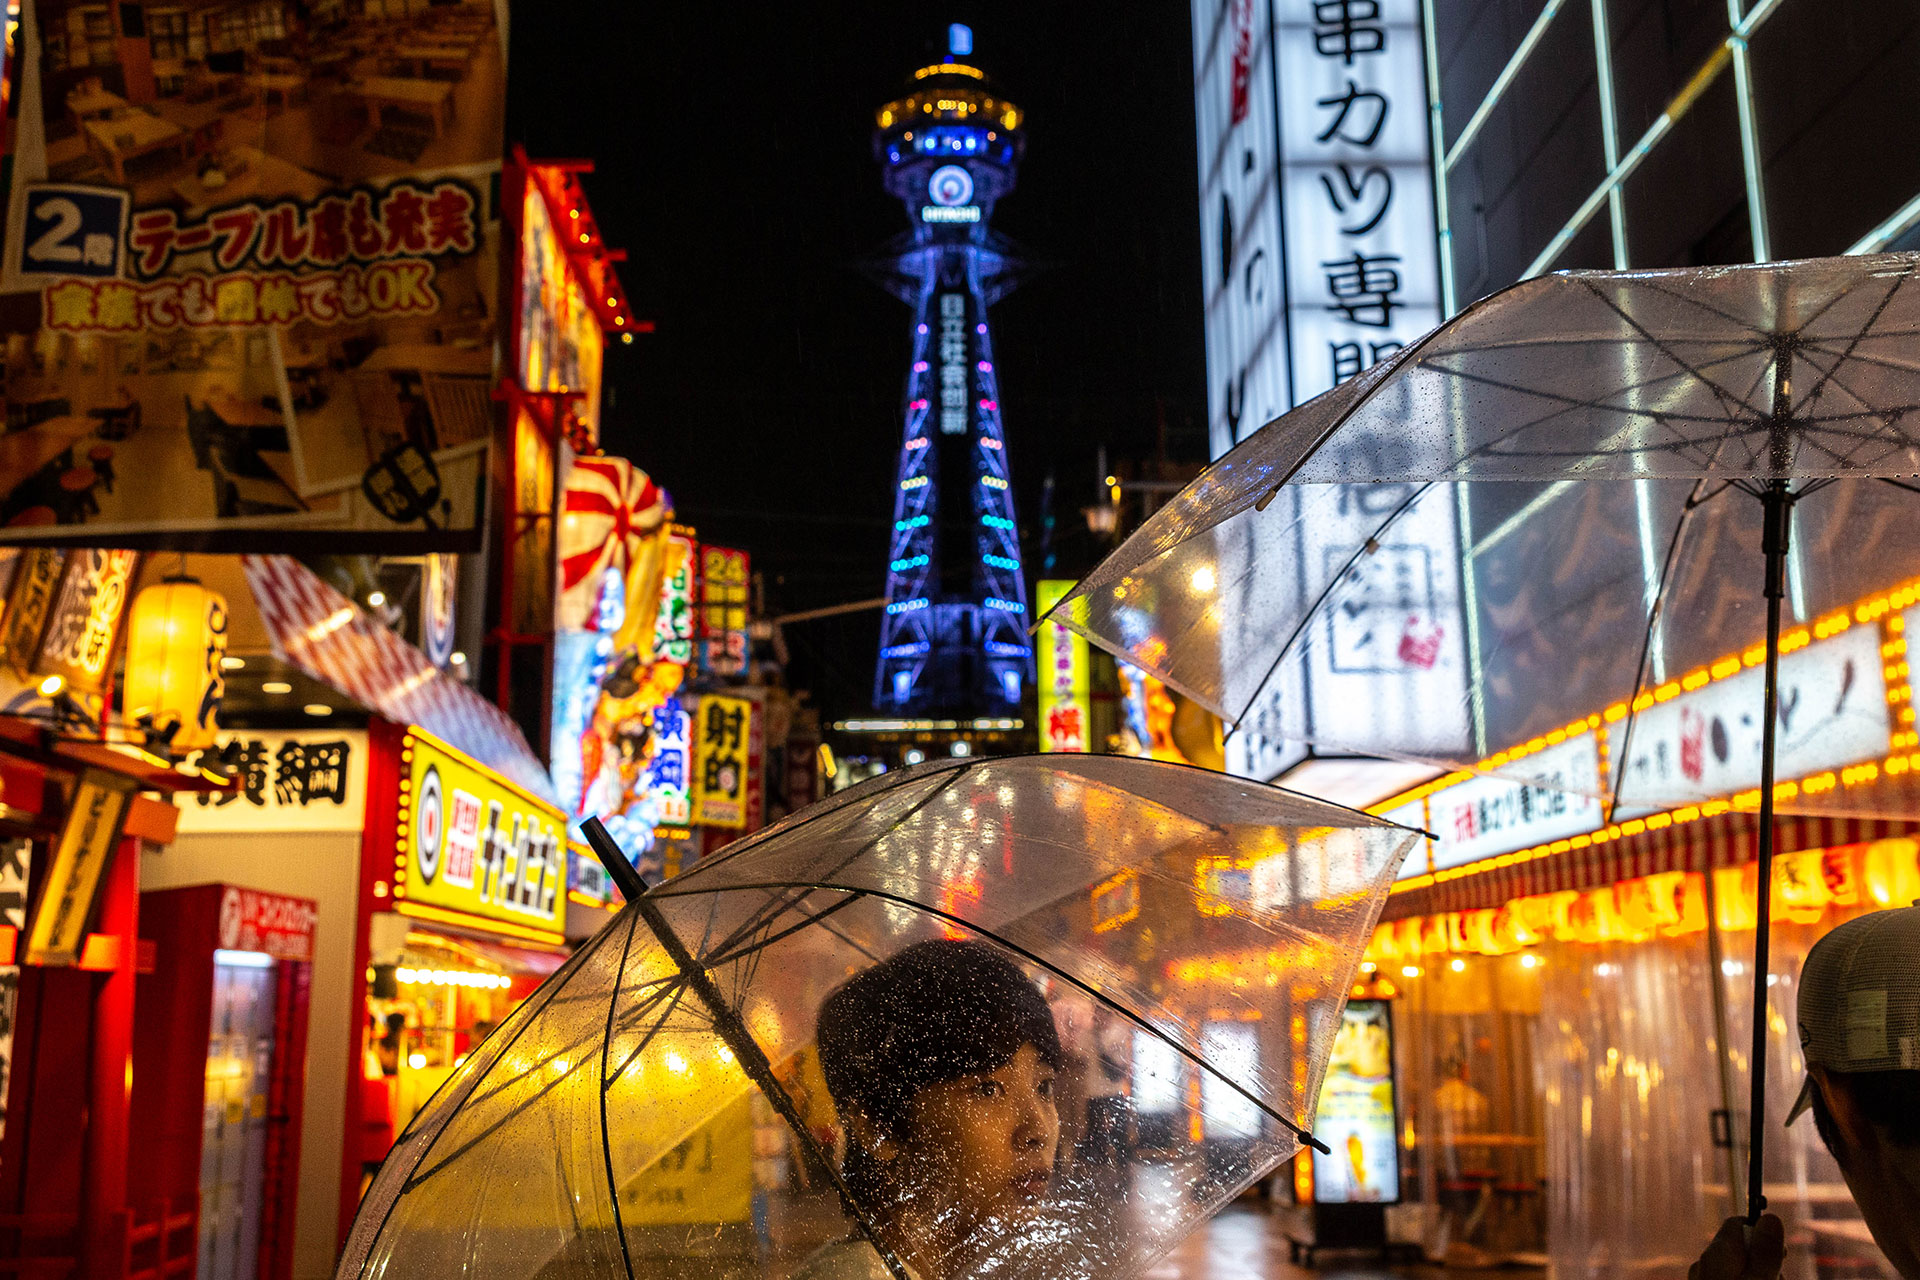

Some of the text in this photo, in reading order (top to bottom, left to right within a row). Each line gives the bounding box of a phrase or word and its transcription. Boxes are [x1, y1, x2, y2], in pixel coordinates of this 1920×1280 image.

[132, 185, 474, 274] テーブル席も充実
[922, 206, 980, 222] HITACHI
[50, 262, 434, 330] 家族でも団体でもOK
[705, 702, 744, 799] 射的
